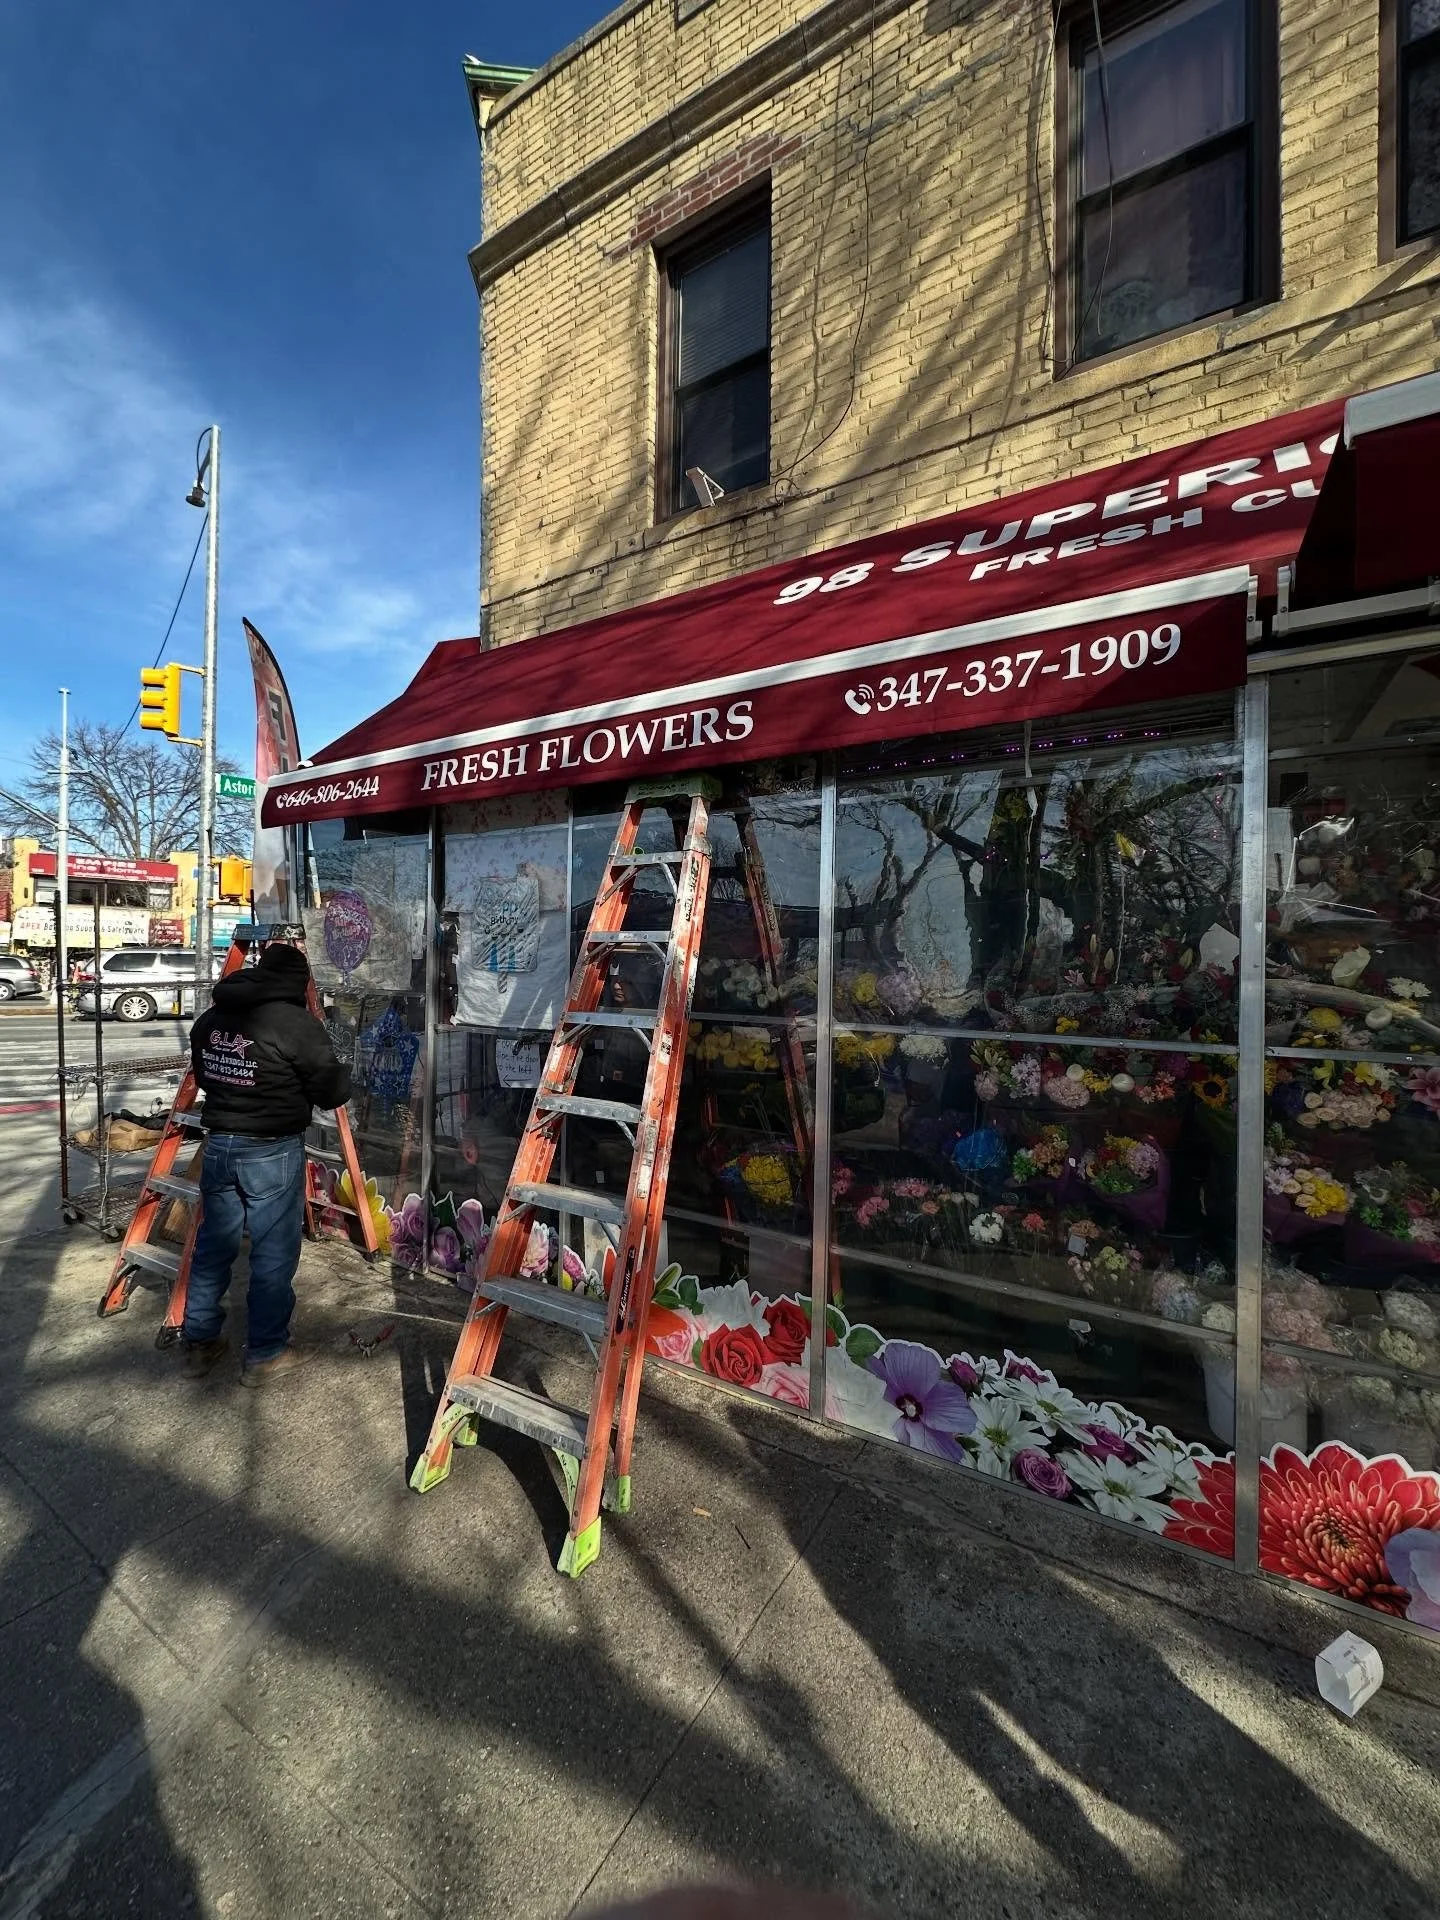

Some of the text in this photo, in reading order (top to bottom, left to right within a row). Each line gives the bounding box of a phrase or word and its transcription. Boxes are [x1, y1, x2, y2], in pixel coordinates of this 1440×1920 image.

[968, 507, 1203, 581] FRESH
[774, 561, 875, 605] 98
[876, 622, 1182, 713] 347-337-1909
[421, 699, 754, 791] FRESH FLOWERS
[286, 775, 380, 808] 646-806-2644
[20, 922, 40, 930] APEX
